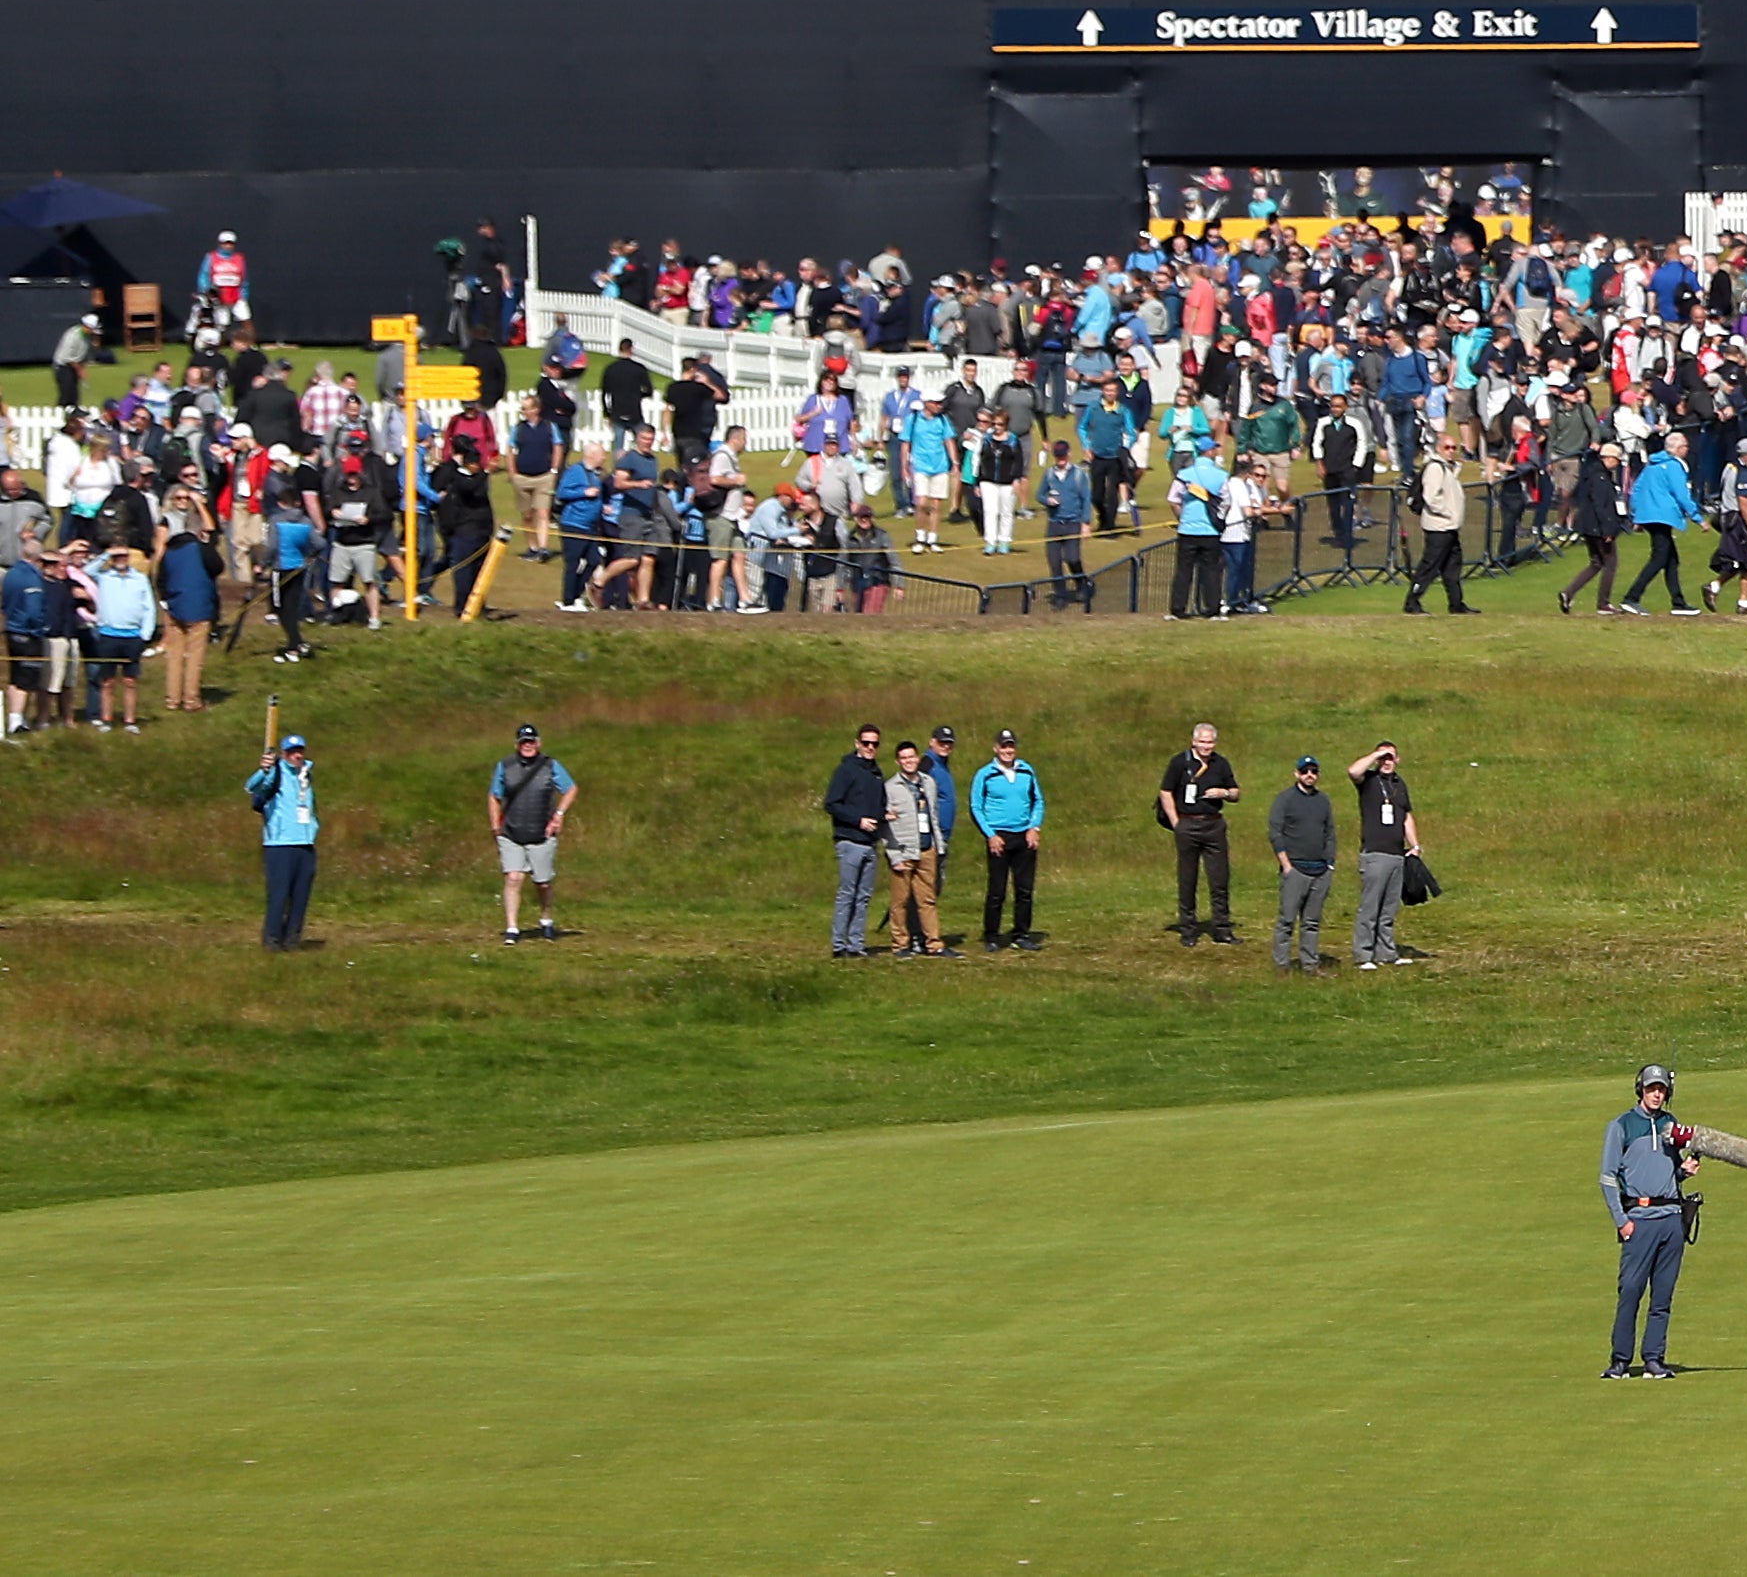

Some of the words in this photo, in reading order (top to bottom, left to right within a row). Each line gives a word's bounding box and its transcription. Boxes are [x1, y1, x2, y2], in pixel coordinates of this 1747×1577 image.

[1156, 10, 1303, 47] Spectator
[1311, 9, 1423, 46] Village
[1431, 10, 1461, 38] &
[1472, 10, 1539, 37] Exit
